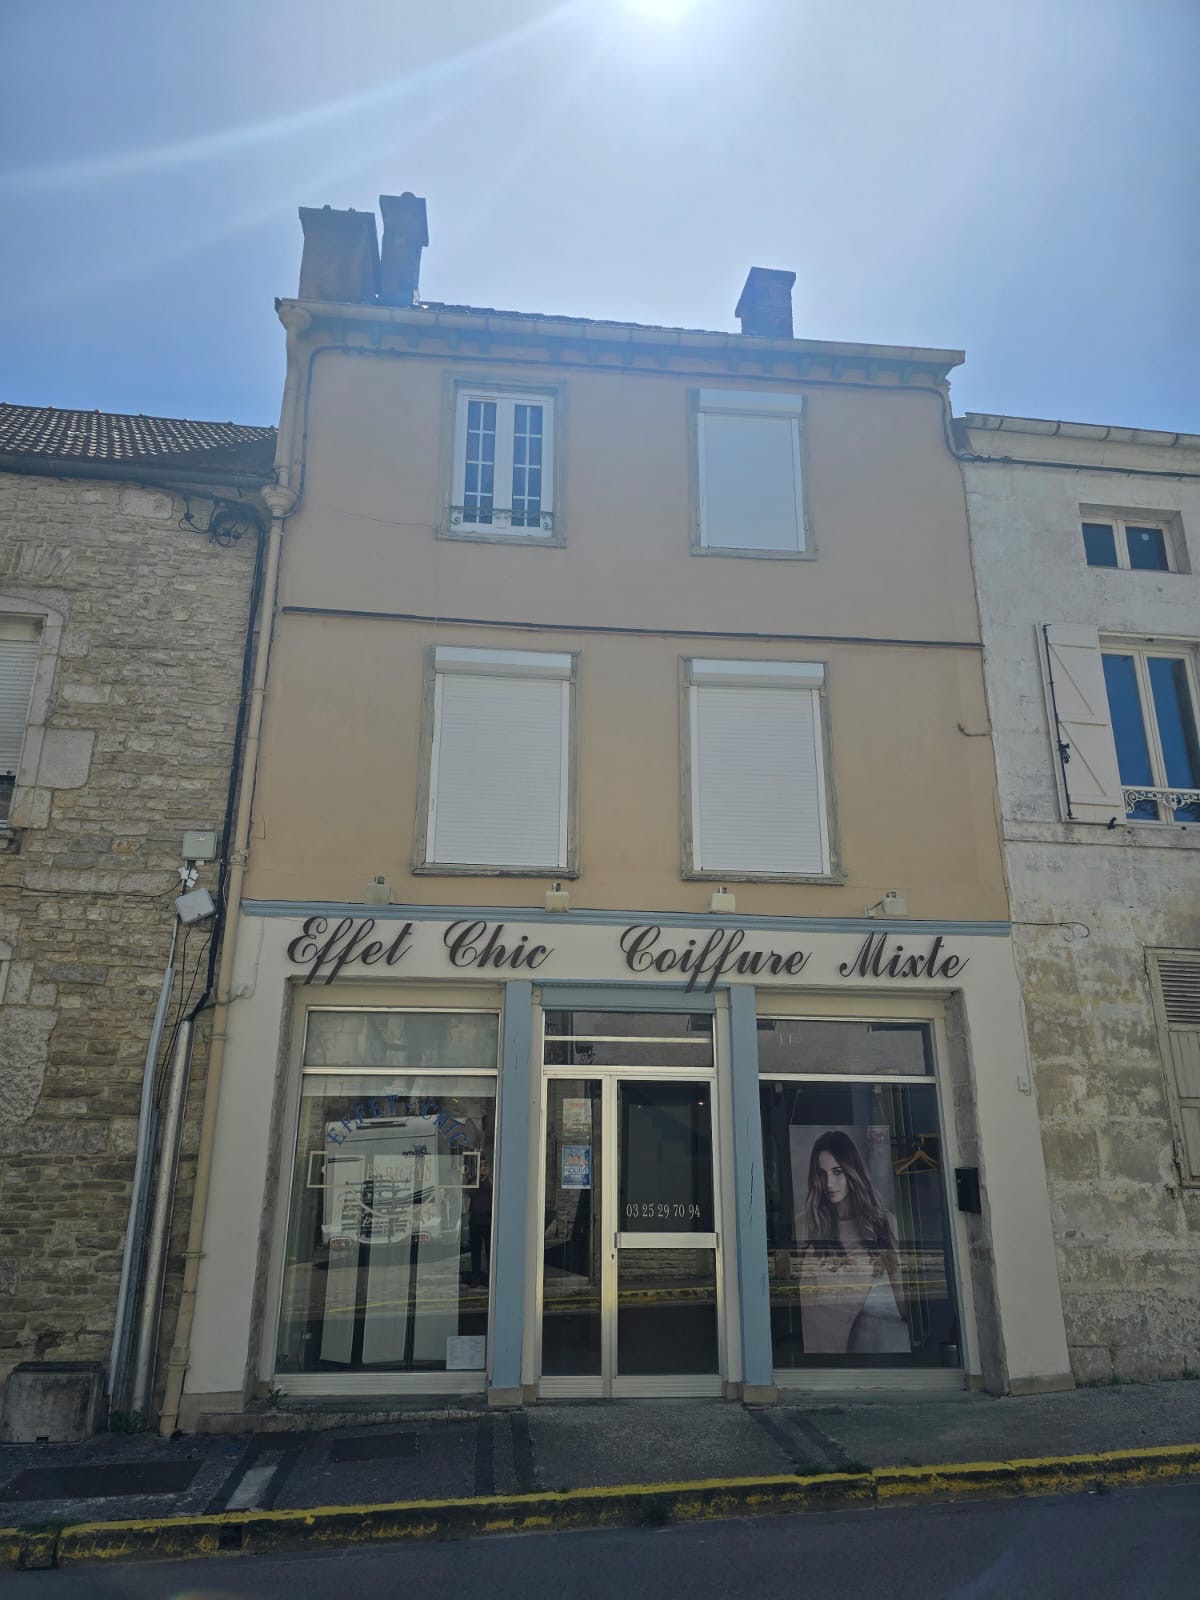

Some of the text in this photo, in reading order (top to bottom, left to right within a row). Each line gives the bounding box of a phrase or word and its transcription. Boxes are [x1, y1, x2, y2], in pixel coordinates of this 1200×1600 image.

[287, 916, 970, 993] Effet Chic Coiffure Mixte
[326, 1094, 400, 1147] EFFET
[626, 1203, 701, 1219] 03 25 29 70 94
